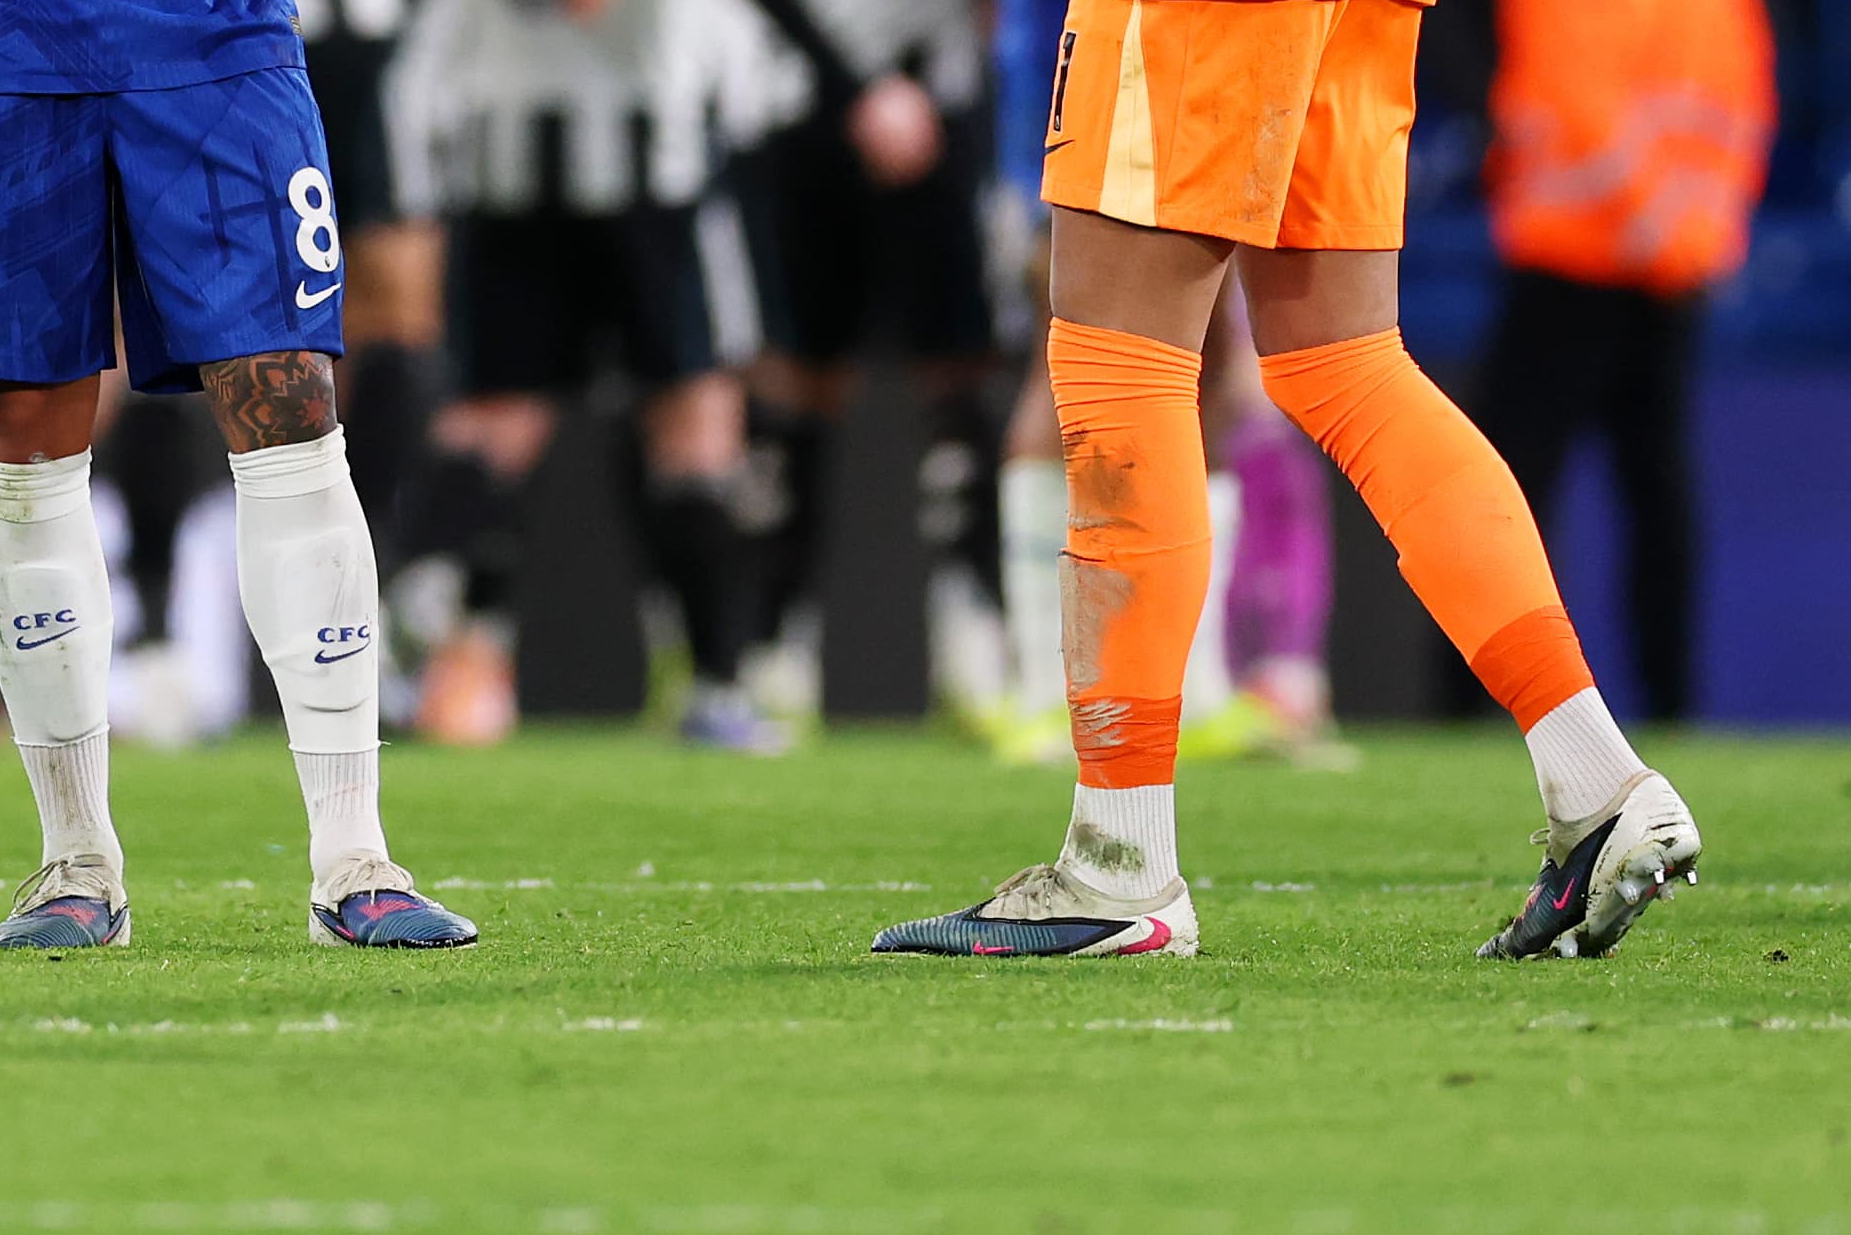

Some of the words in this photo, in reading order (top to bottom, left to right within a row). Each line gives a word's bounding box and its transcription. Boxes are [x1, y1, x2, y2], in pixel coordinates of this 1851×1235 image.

[287, 166, 340, 273] 8
[13, 608, 77, 631] CFC
[316, 623, 371, 644] CFC
